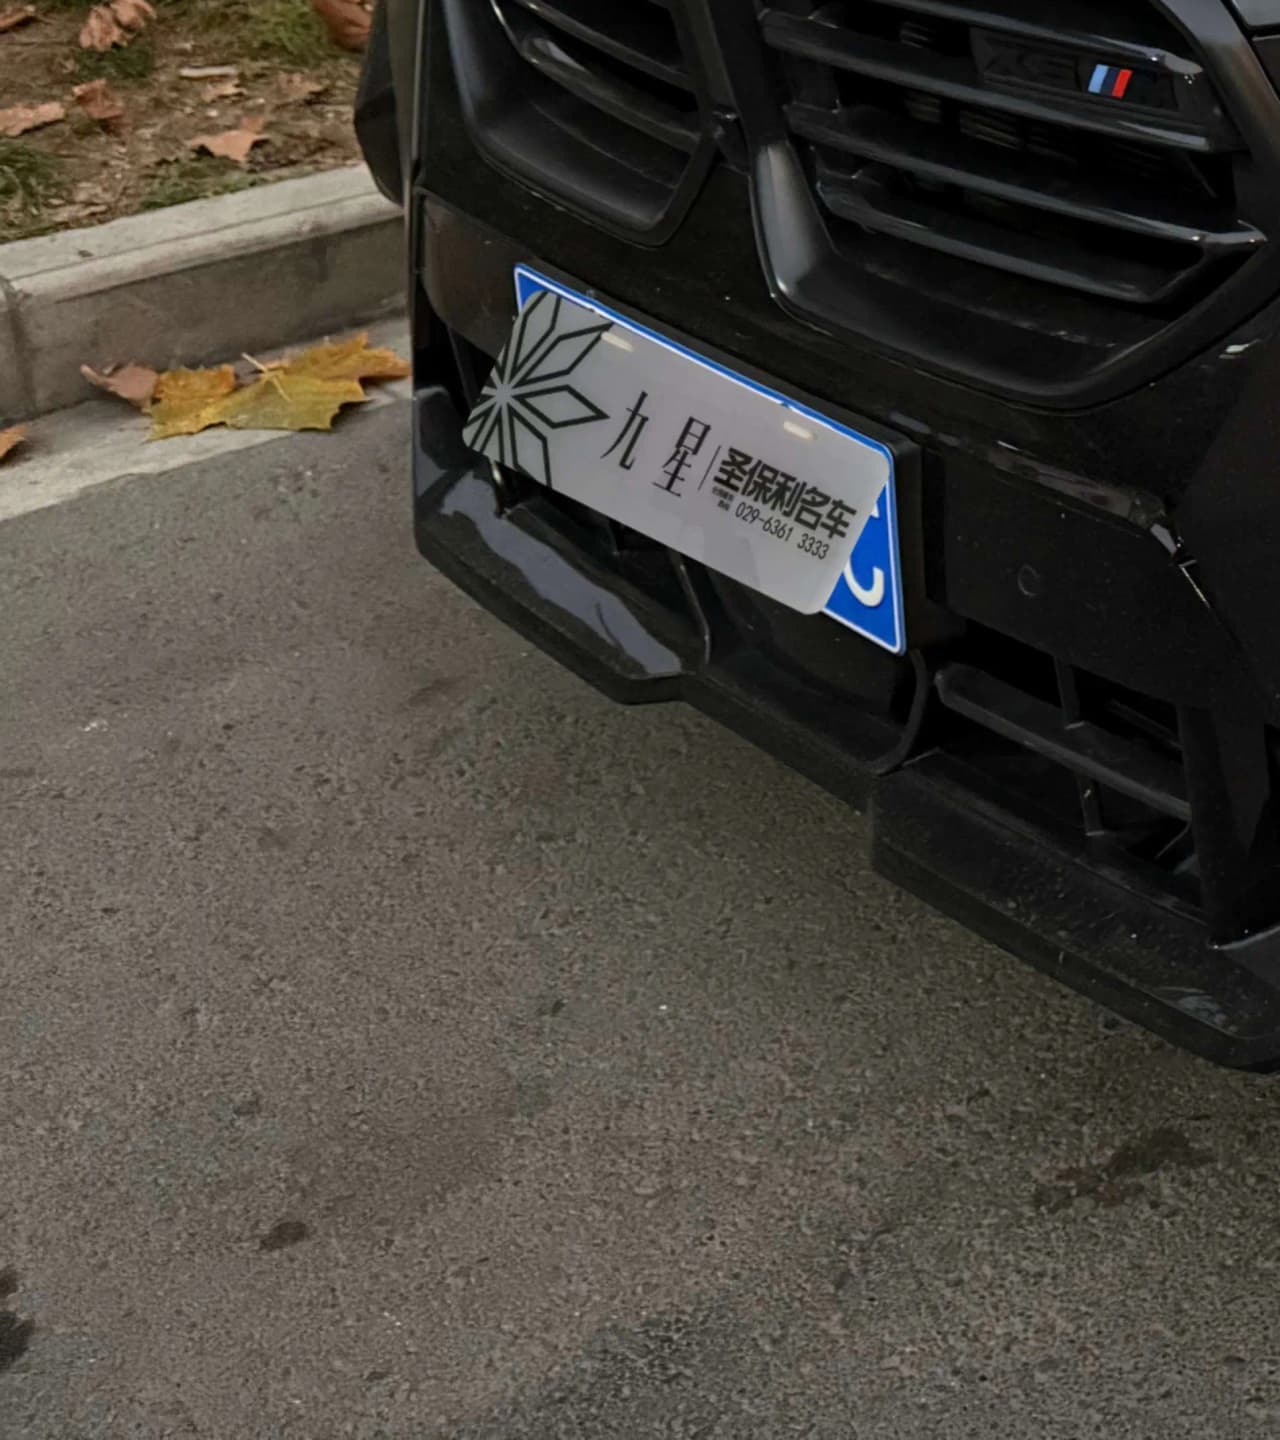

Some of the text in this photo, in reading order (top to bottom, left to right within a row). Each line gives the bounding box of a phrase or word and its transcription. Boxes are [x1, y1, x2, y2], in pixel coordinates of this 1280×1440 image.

[600, 390, 712, 498] 九星
[713, 446, 857, 540] 圣保利名车
[735, 501, 830, 560] 029-6361 3333
